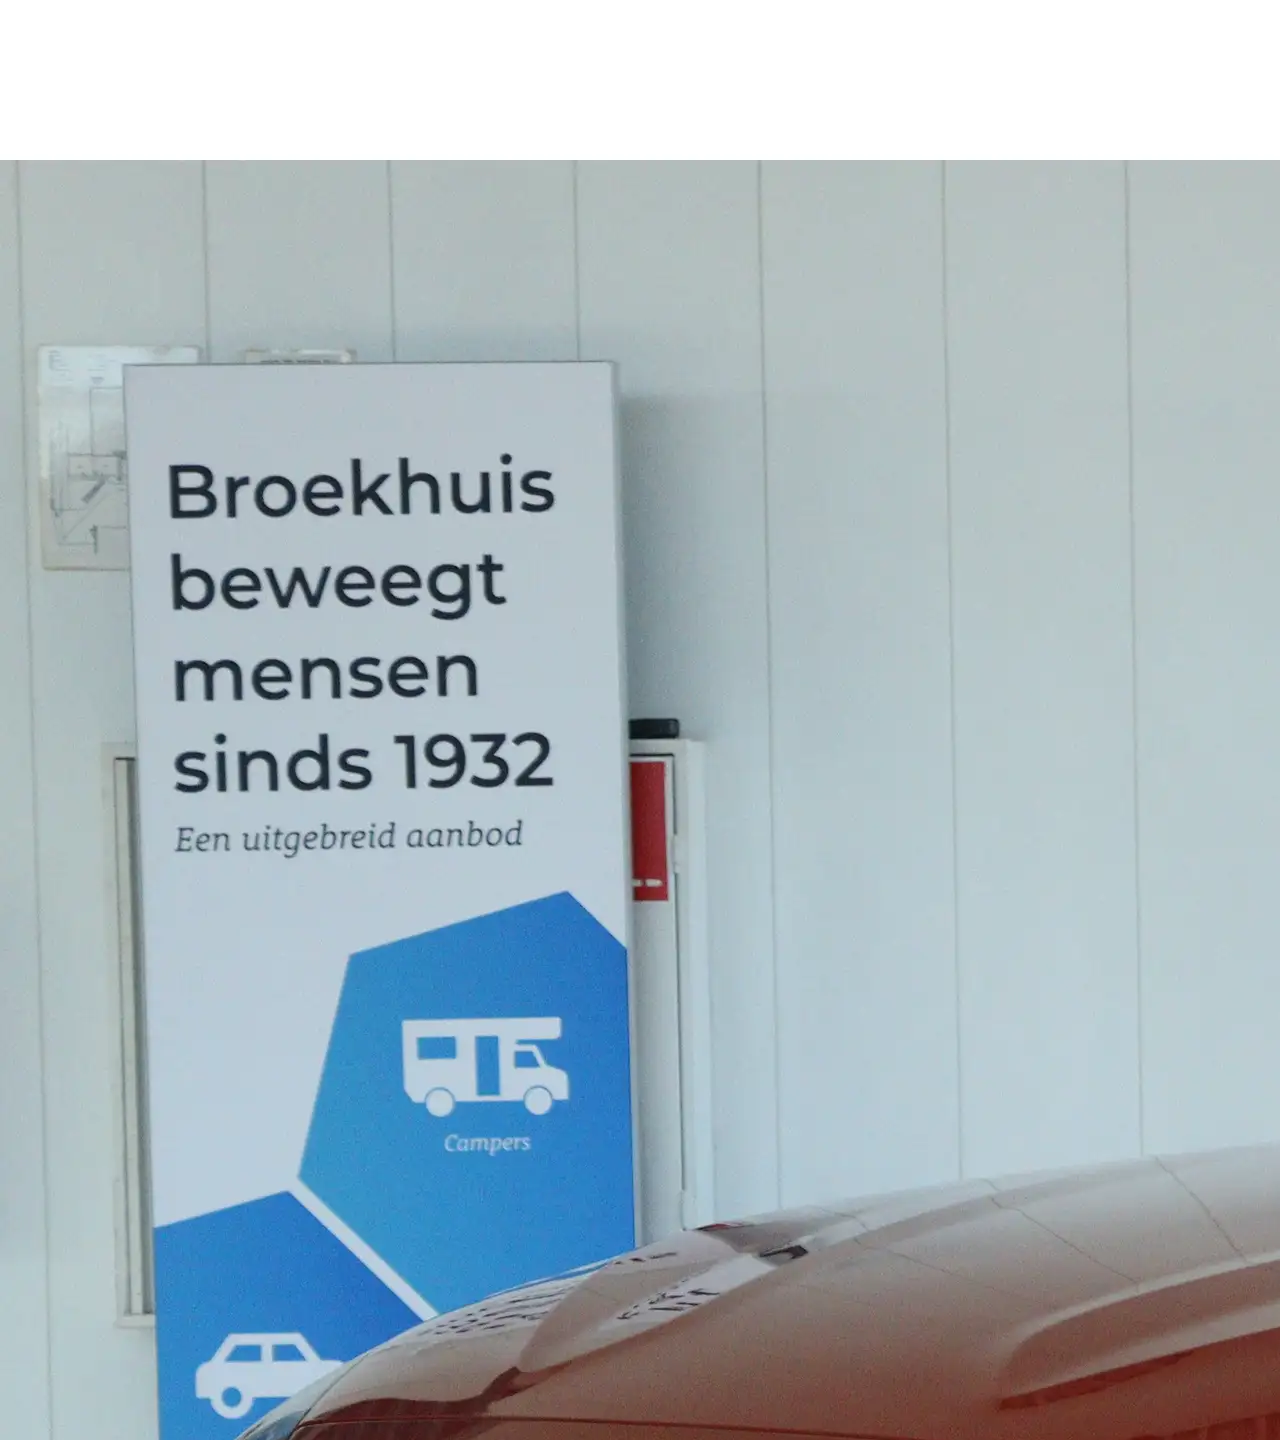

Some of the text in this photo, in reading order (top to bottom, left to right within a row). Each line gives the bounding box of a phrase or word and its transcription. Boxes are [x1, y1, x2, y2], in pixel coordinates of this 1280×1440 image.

[168, 453, 555, 520] Broekhuis
[170, 552, 507, 621] beweegt
[174, 654, 478, 702] mensen
[174, 731, 554, 794] sinds 1932
[174, 819, 523, 859] Een uitgebreid aanbod
[444, 1133, 531, 1157] Campers
